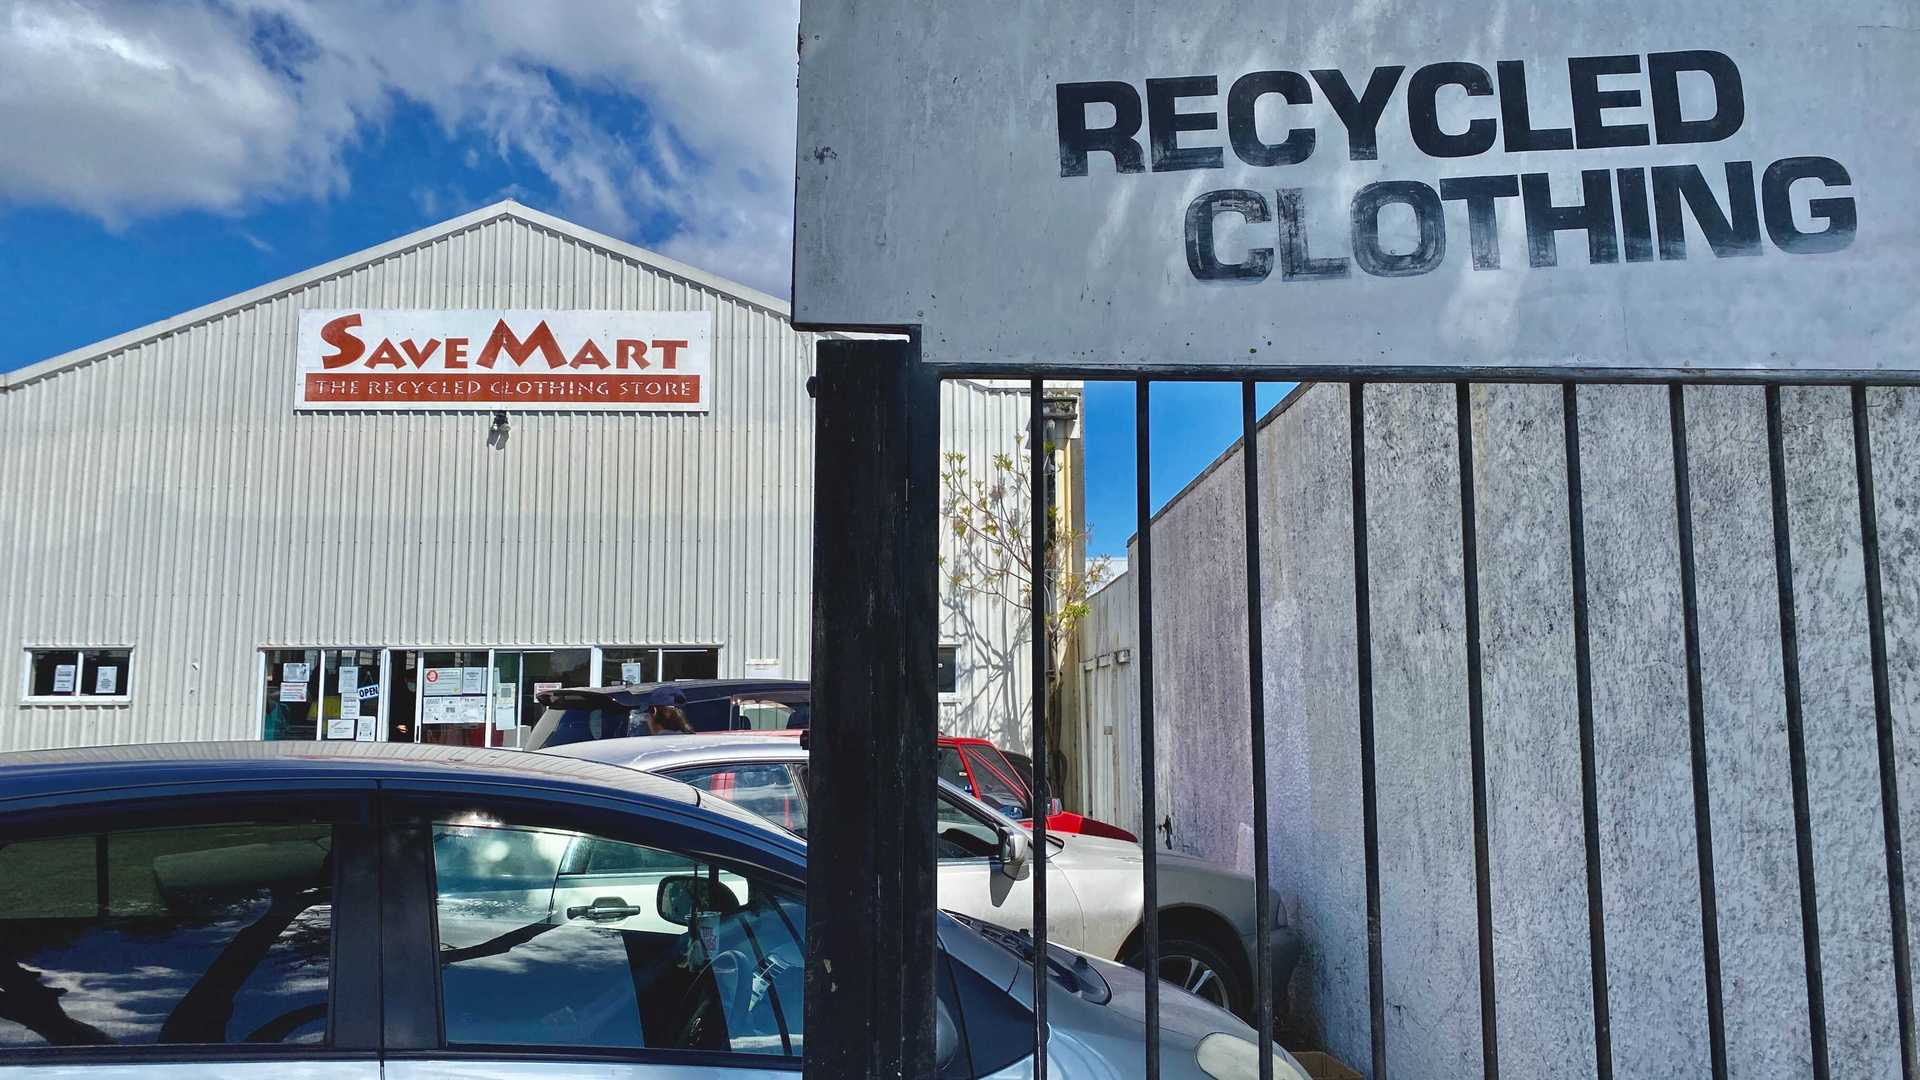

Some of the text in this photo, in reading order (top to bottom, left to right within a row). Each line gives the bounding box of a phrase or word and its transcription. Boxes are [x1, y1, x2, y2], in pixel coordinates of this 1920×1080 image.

[1056, 49, 1745, 178] RECYCLED
[1184, 155, 1857, 284] CLOTHING
[315, 380, 691, 395] THE RECYCLED CLOTHING STORE
[359, 685, 379, 698] OPEN
